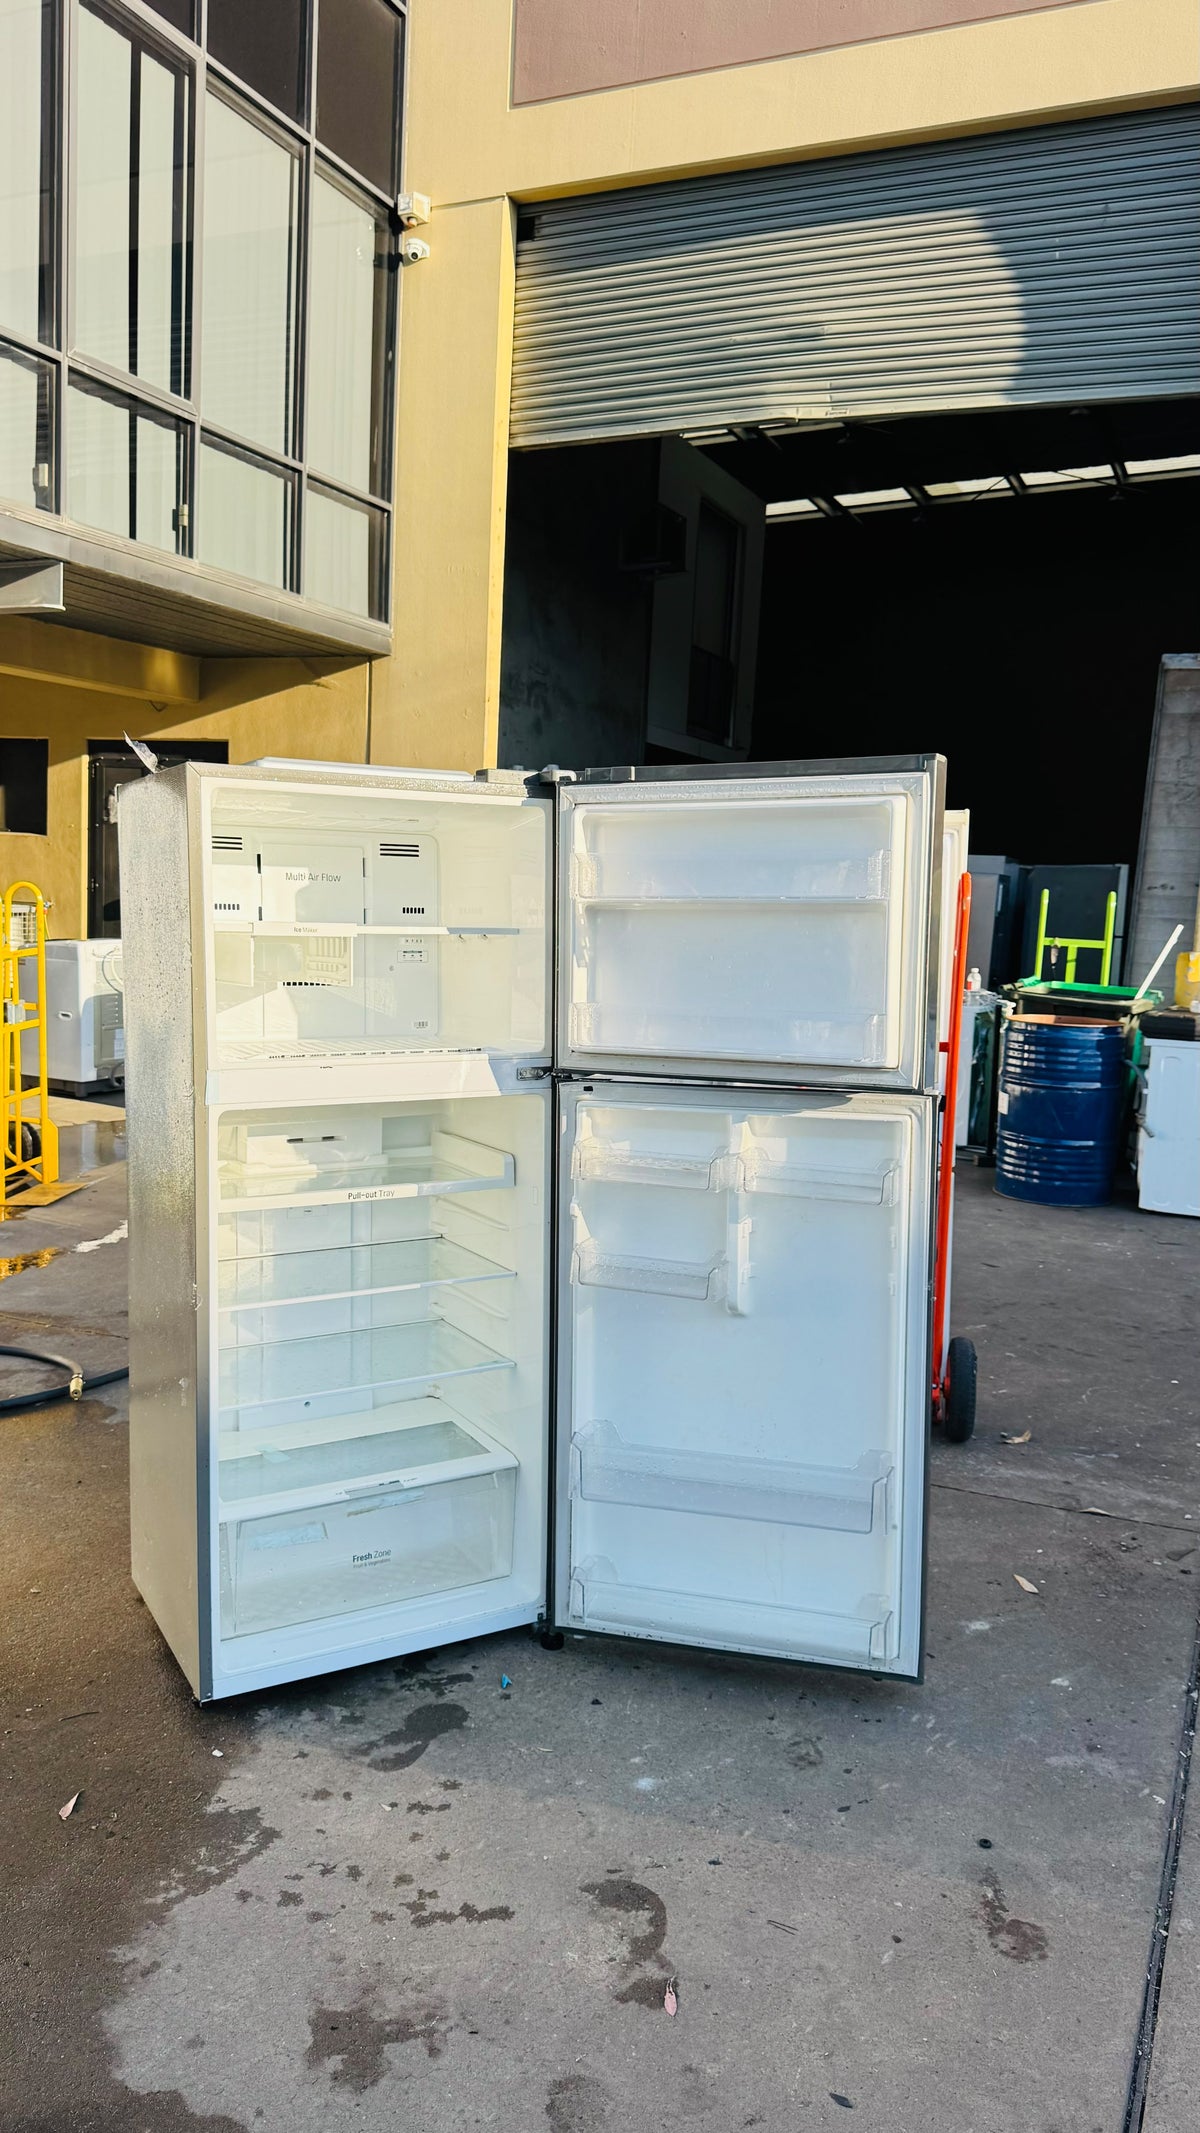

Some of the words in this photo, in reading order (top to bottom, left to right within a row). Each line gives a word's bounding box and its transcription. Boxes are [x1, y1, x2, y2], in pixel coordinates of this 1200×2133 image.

[285, 872, 306, 881] Multi
[308, 872, 319, 881] Air
[321, 872, 341, 882] Flow
[347, 1191, 377, 1200] Pull-out
[378, 1189, 395, 1198] Tray
[352, 1552, 373, 1563] Fresh
[373, 1549, 392, 1559] Zone
